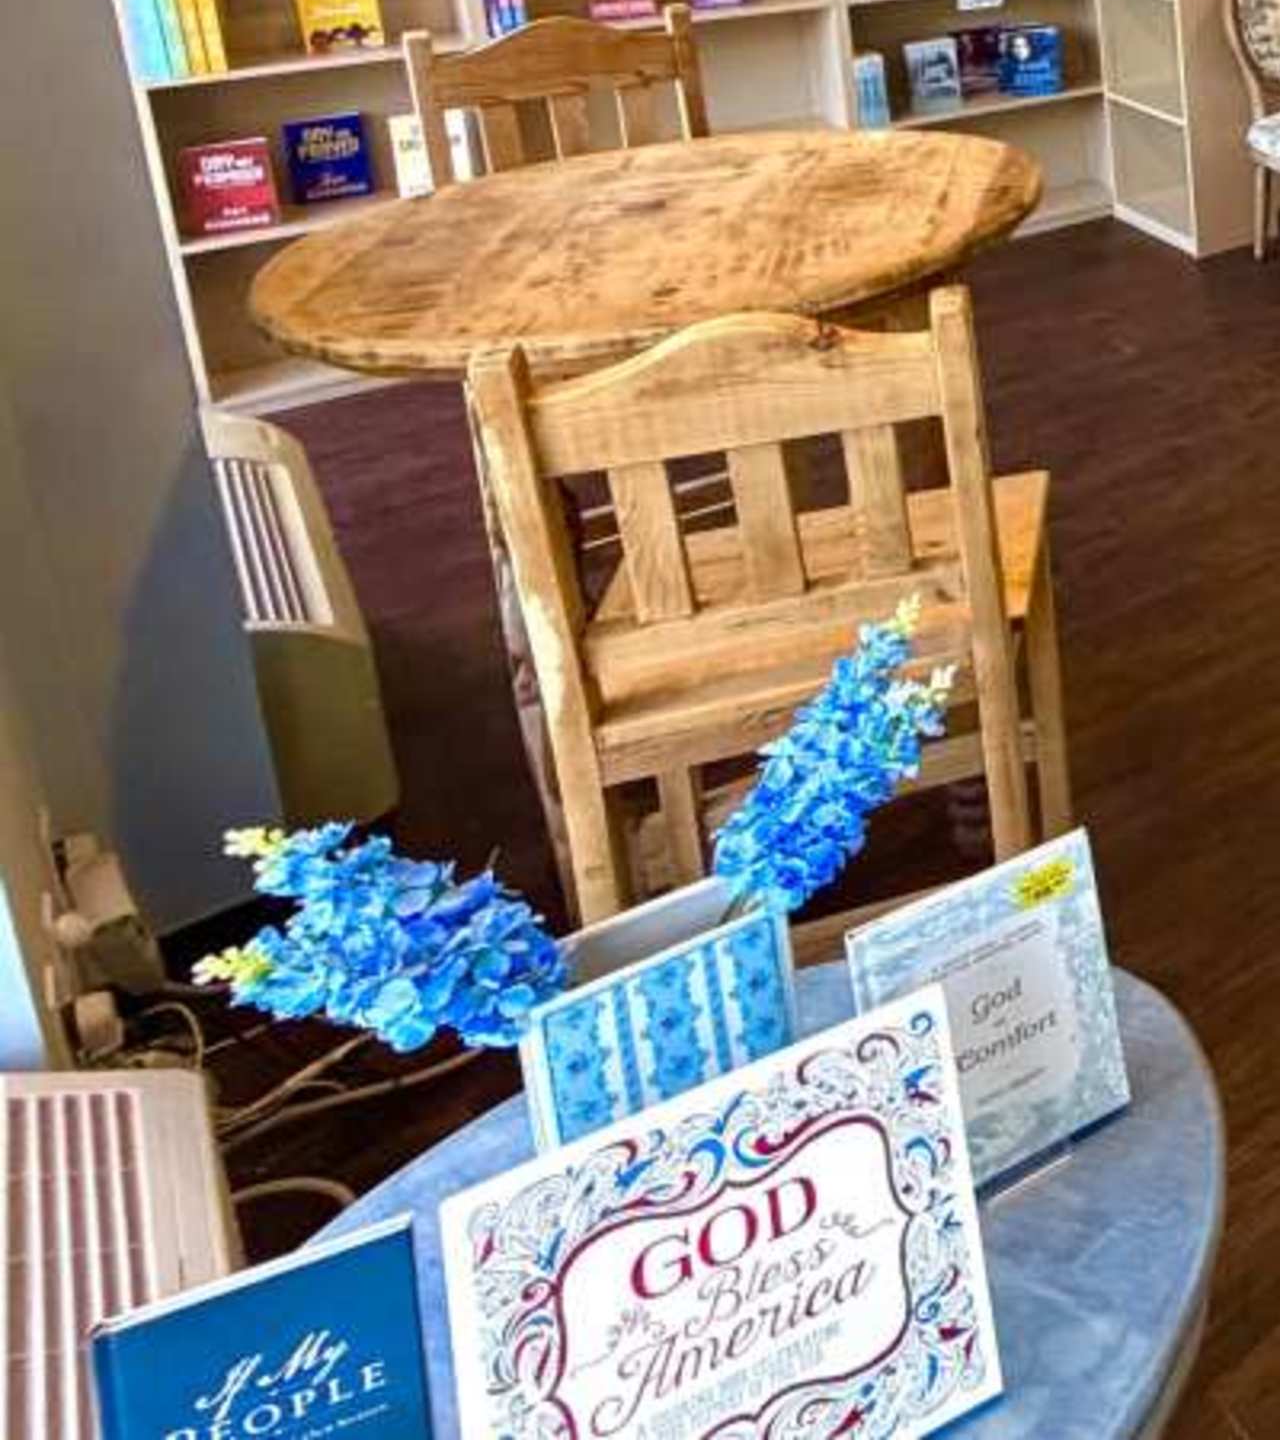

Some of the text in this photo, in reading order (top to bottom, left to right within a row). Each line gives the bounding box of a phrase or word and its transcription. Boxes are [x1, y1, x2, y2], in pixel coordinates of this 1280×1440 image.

[955, 1010, 1058, 1073] Comfort
[971, 977, 1023, 1025] God
[631, 1177, 816, 1301] GOD
[684, 1238, 837, 1338] Bless
[257, 1329, 349, 1389] My
[591, 1258, 872, 1438] America
